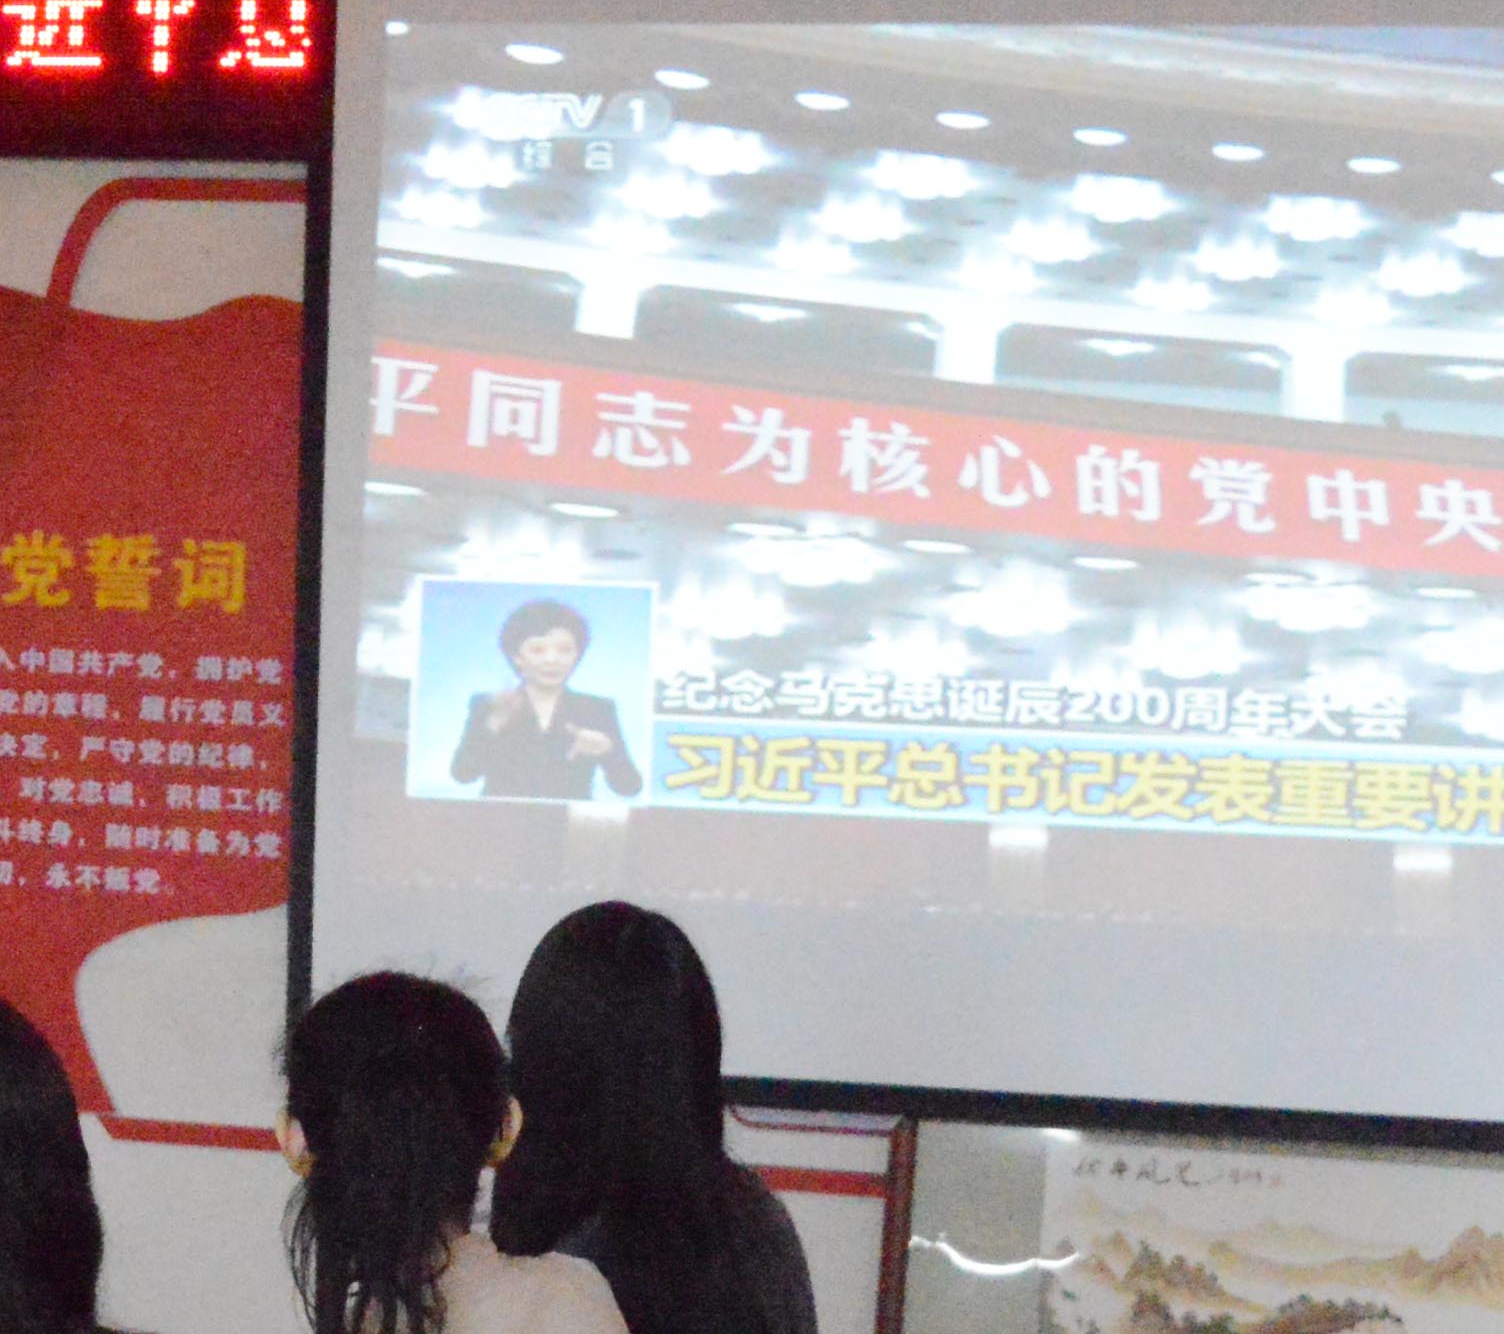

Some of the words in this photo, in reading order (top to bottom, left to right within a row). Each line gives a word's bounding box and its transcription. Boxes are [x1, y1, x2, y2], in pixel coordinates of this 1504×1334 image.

[629, 97, 645, 133] 1
[660, 667, 1410, 740] 纪念马克思诞辰200周年大会
